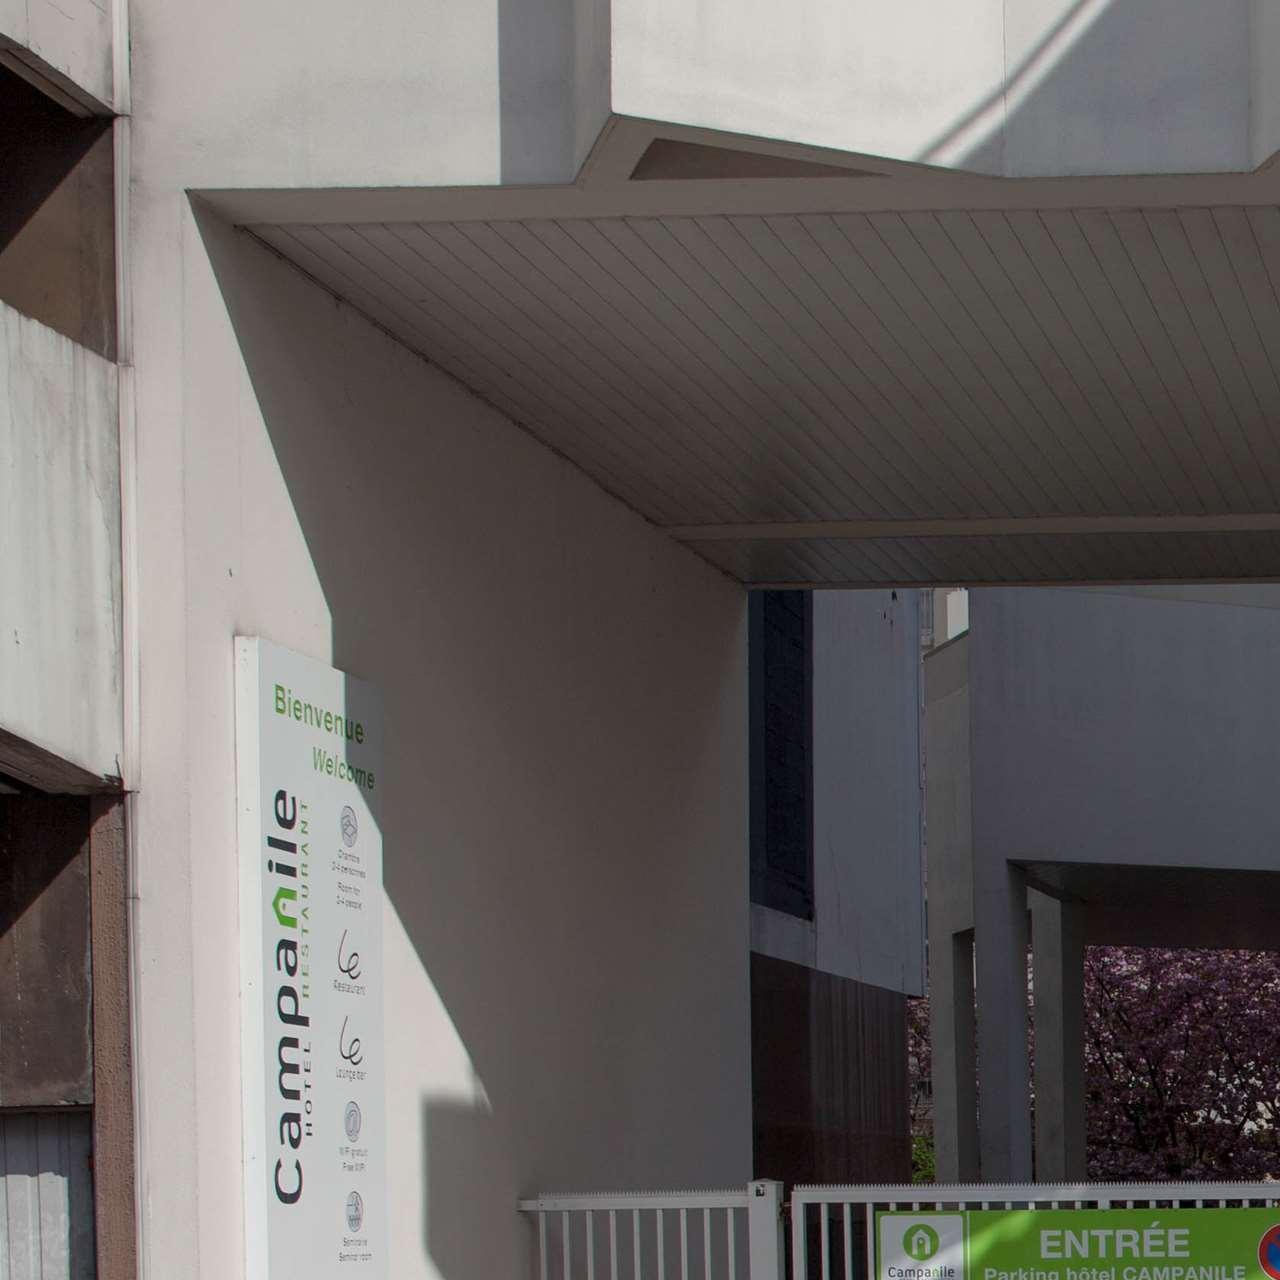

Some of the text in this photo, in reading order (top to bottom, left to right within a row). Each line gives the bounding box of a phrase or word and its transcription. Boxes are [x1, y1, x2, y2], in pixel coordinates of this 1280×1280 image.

[274, 684, 365, 745] Bienvenue
[312, 746, 376, 790] Welcome
[300, 800, 313, 1137] HOTEL RESTAURANT
[266, 789, 311, 1205] Campanile
[1040, 1222, 1190, 1259] ENTRÉE
[888, 1265, 955, 1280] Campanile
